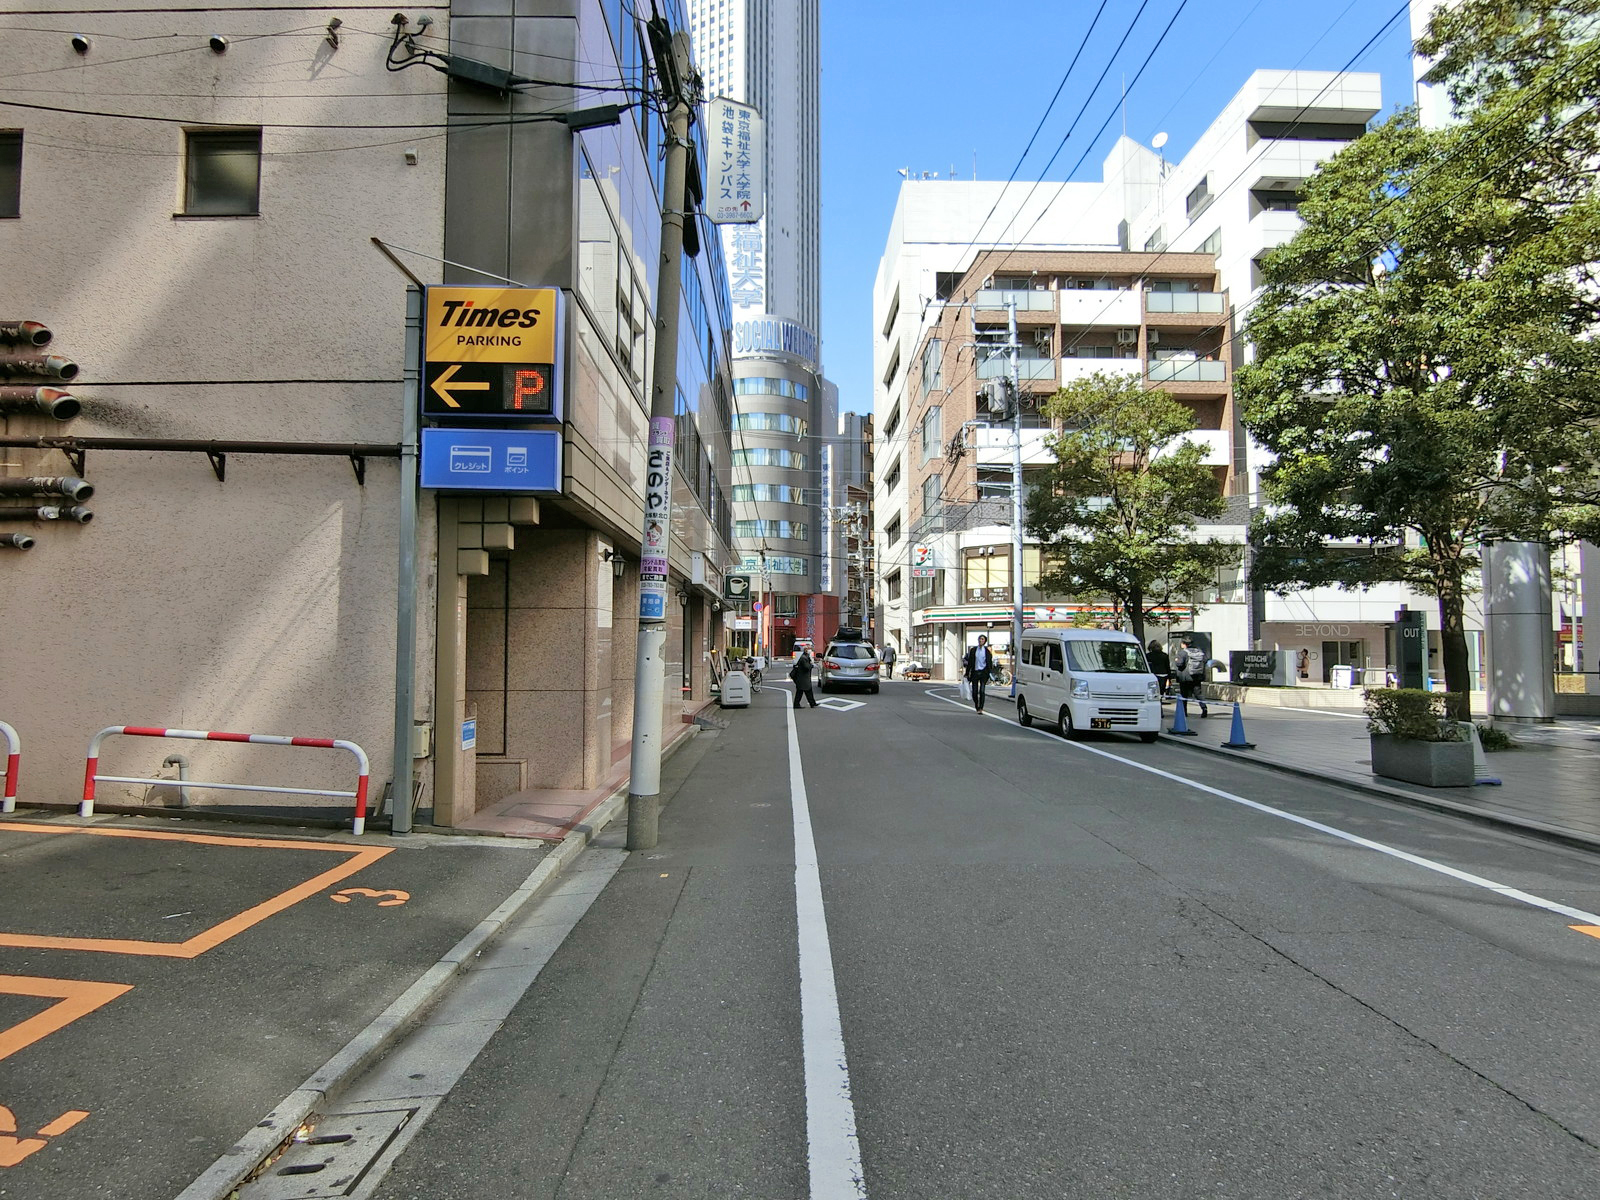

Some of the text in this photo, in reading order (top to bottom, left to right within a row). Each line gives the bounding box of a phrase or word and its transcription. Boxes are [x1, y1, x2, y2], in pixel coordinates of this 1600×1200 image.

[721, 104, 735, 199] 池袋キャンパス
[440, 300, 541, 329] Times
[457, 335, 522, 346] PARKING
[735, 320, 818, 364] SOCIAL WELFARE
[513, 369, 544, 410] P
[454, 462, 488, 470] クレジット
[504, 466, 530, 474] ポイント
[647, 450, 664, 509] さのや
[1295, 624, 1350, 637] BEYOND
[1403, 628, 1420, 638] OUT
